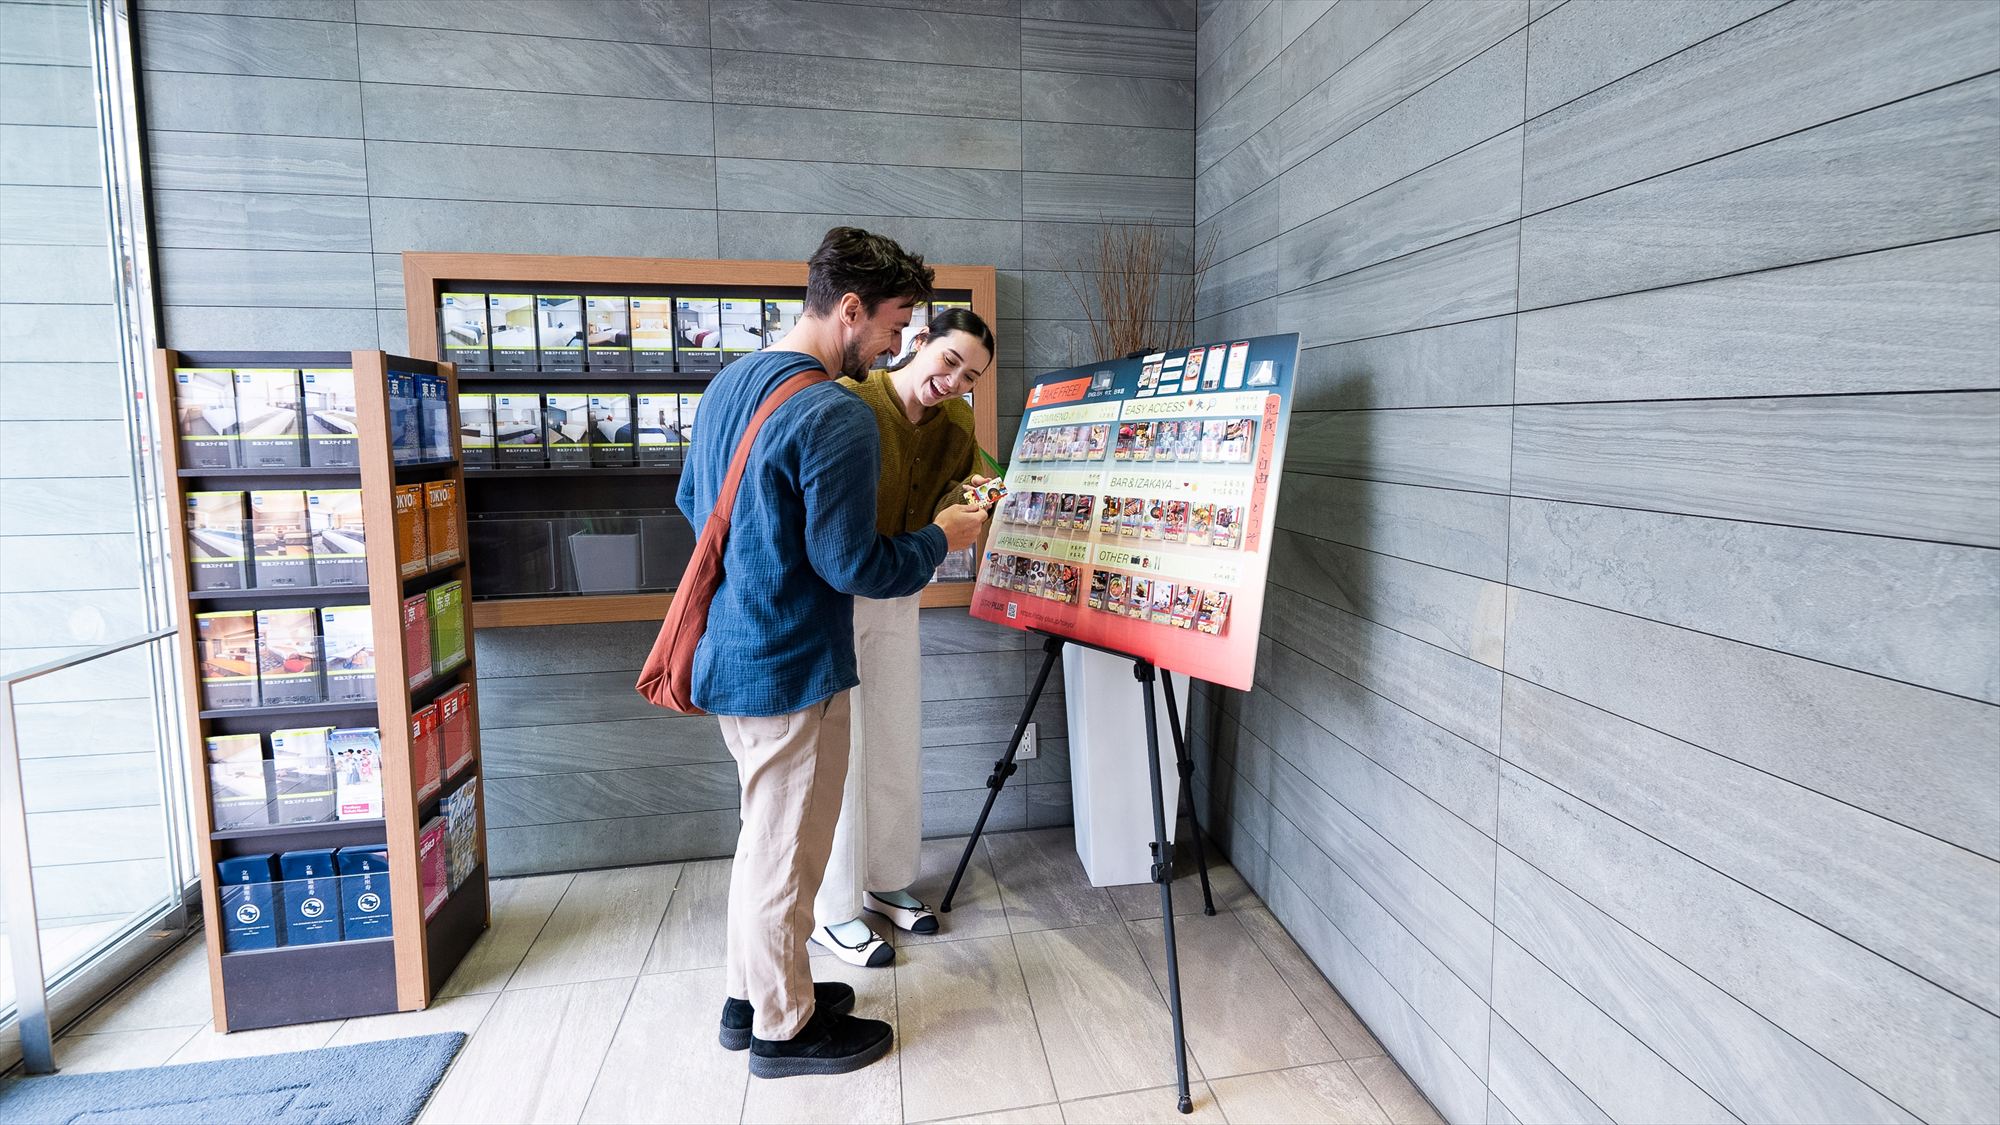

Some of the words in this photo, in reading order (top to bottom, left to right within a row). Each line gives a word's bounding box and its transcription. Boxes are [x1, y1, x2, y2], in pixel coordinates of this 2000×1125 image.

[388, 379, 399, 395] 京
[422, 382, 437, 397] 東京
[1042, 386, 1061, 400] TAKE
[1059, 383, 1082, 398] FREE!
[1125, 403, 1147, 415] EASY
[1148, 401, 1187, 414] ACCESS
[1015, 474, 1031, 484] MEAT
[1110, 477, 1172, 489] BAR&IZAKAYA
[396, 493, 413, 509] OKYO
[429, 489, 448, 503] TOKYO
[998, 536, 1029, 548] JAPANESE
[1099, 551, 1130, 564] OTHER
[404, 607, 416, 623] 京
[444, 697, 458, 719] 도쿄
